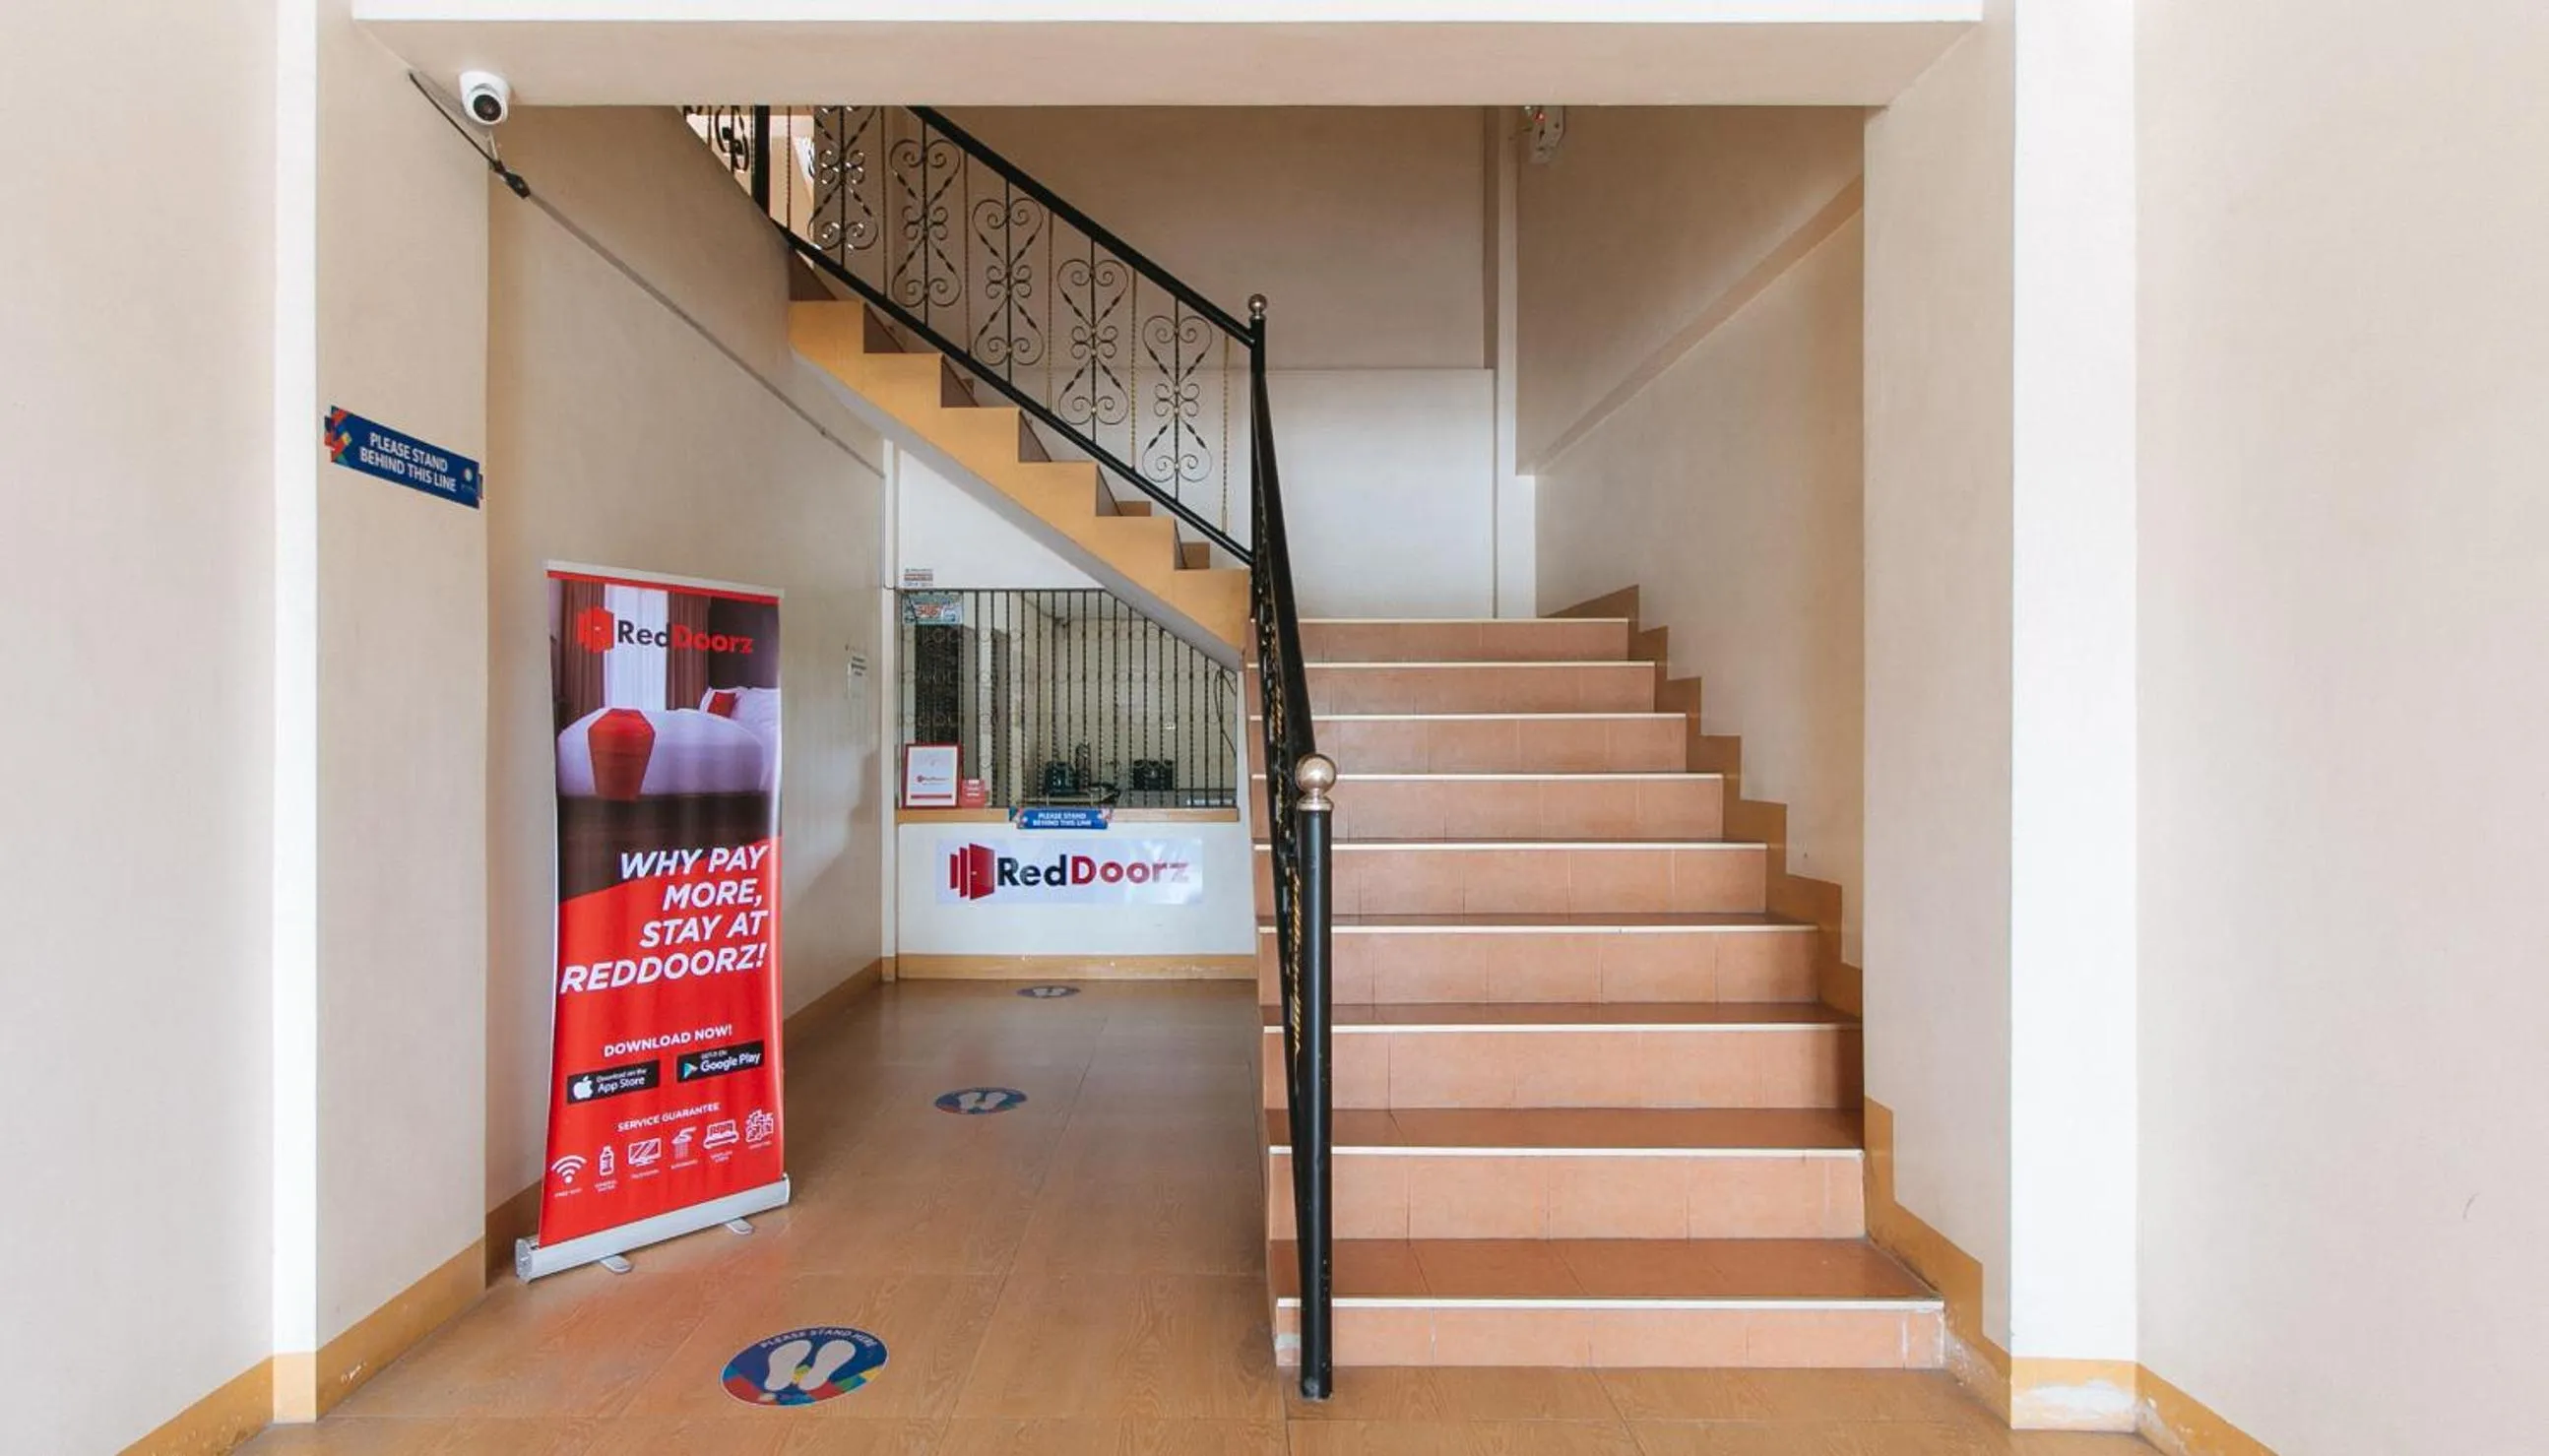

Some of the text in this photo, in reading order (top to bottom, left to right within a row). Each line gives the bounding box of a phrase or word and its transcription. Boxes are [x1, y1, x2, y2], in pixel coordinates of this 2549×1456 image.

[360, 446, 405, 475] BEHIND
[408, 464, 431, 484] THIS
[433, 474, 456, 492] LINE
[370, 433, 448, 472] PLEASE STAND
[617, 620, 753, 654] RedDoorz
[1038, 811, 1086, 820] PLEASE STAND
[620, 845, 769, 879] WHY PAY
[997, 855, 1189, 886] RedDoorz
[663, 878, 762, 912] MORE,
[639, 911, 769, 948] STAY AT
[559, 943, 767, 993] REDDOORZ!
[604, 1024, 733, 1057] DOWNLOAD NOW!
[700, 1052, 761, 1072] Google Play
[598, 1077, 645, 1094] App Store
[616, 1103, 720, 1132] SERVICE GUARANTEE
[760, 1329, 878, 1349] PLEASE STAND HERE
